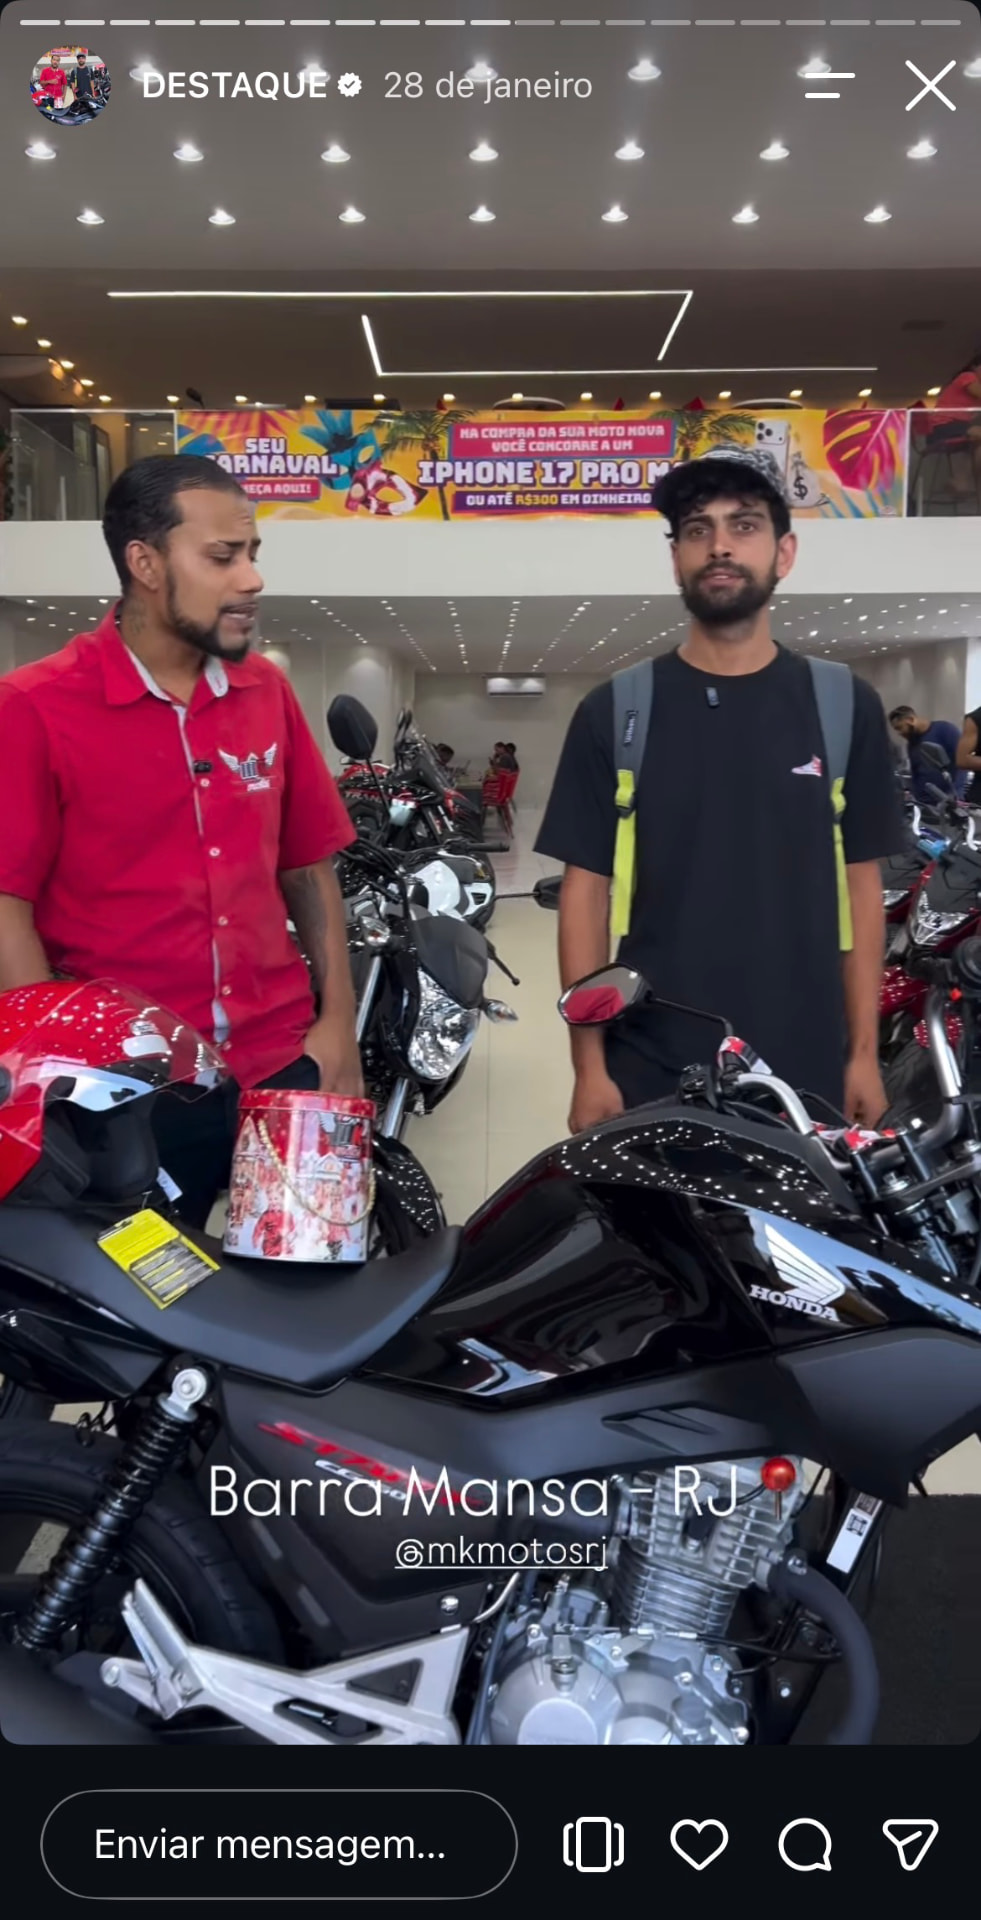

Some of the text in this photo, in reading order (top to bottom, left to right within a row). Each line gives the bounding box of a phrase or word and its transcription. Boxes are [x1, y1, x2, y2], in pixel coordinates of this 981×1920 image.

[460, 424, 665, 439] NA COMPRA DA SUA MOTO NOVA
[245, 438, 286, 454] SEU
[491, 438, 634, 452] VOCÊ CONCORRE A UM
[204, 454, 338, 474] ARNAVAL
[418, 461, 535, 484] IPHONE
[540, 461, 575, 484] 17
[581, 461, 640, 484] PRO
[273, 482, 312, 495] AQUI!
[466, 492, 652, 506] OU ATÉ R$300 EM DINHEIRO
[750, 1284, 841, 1322] HONDA
